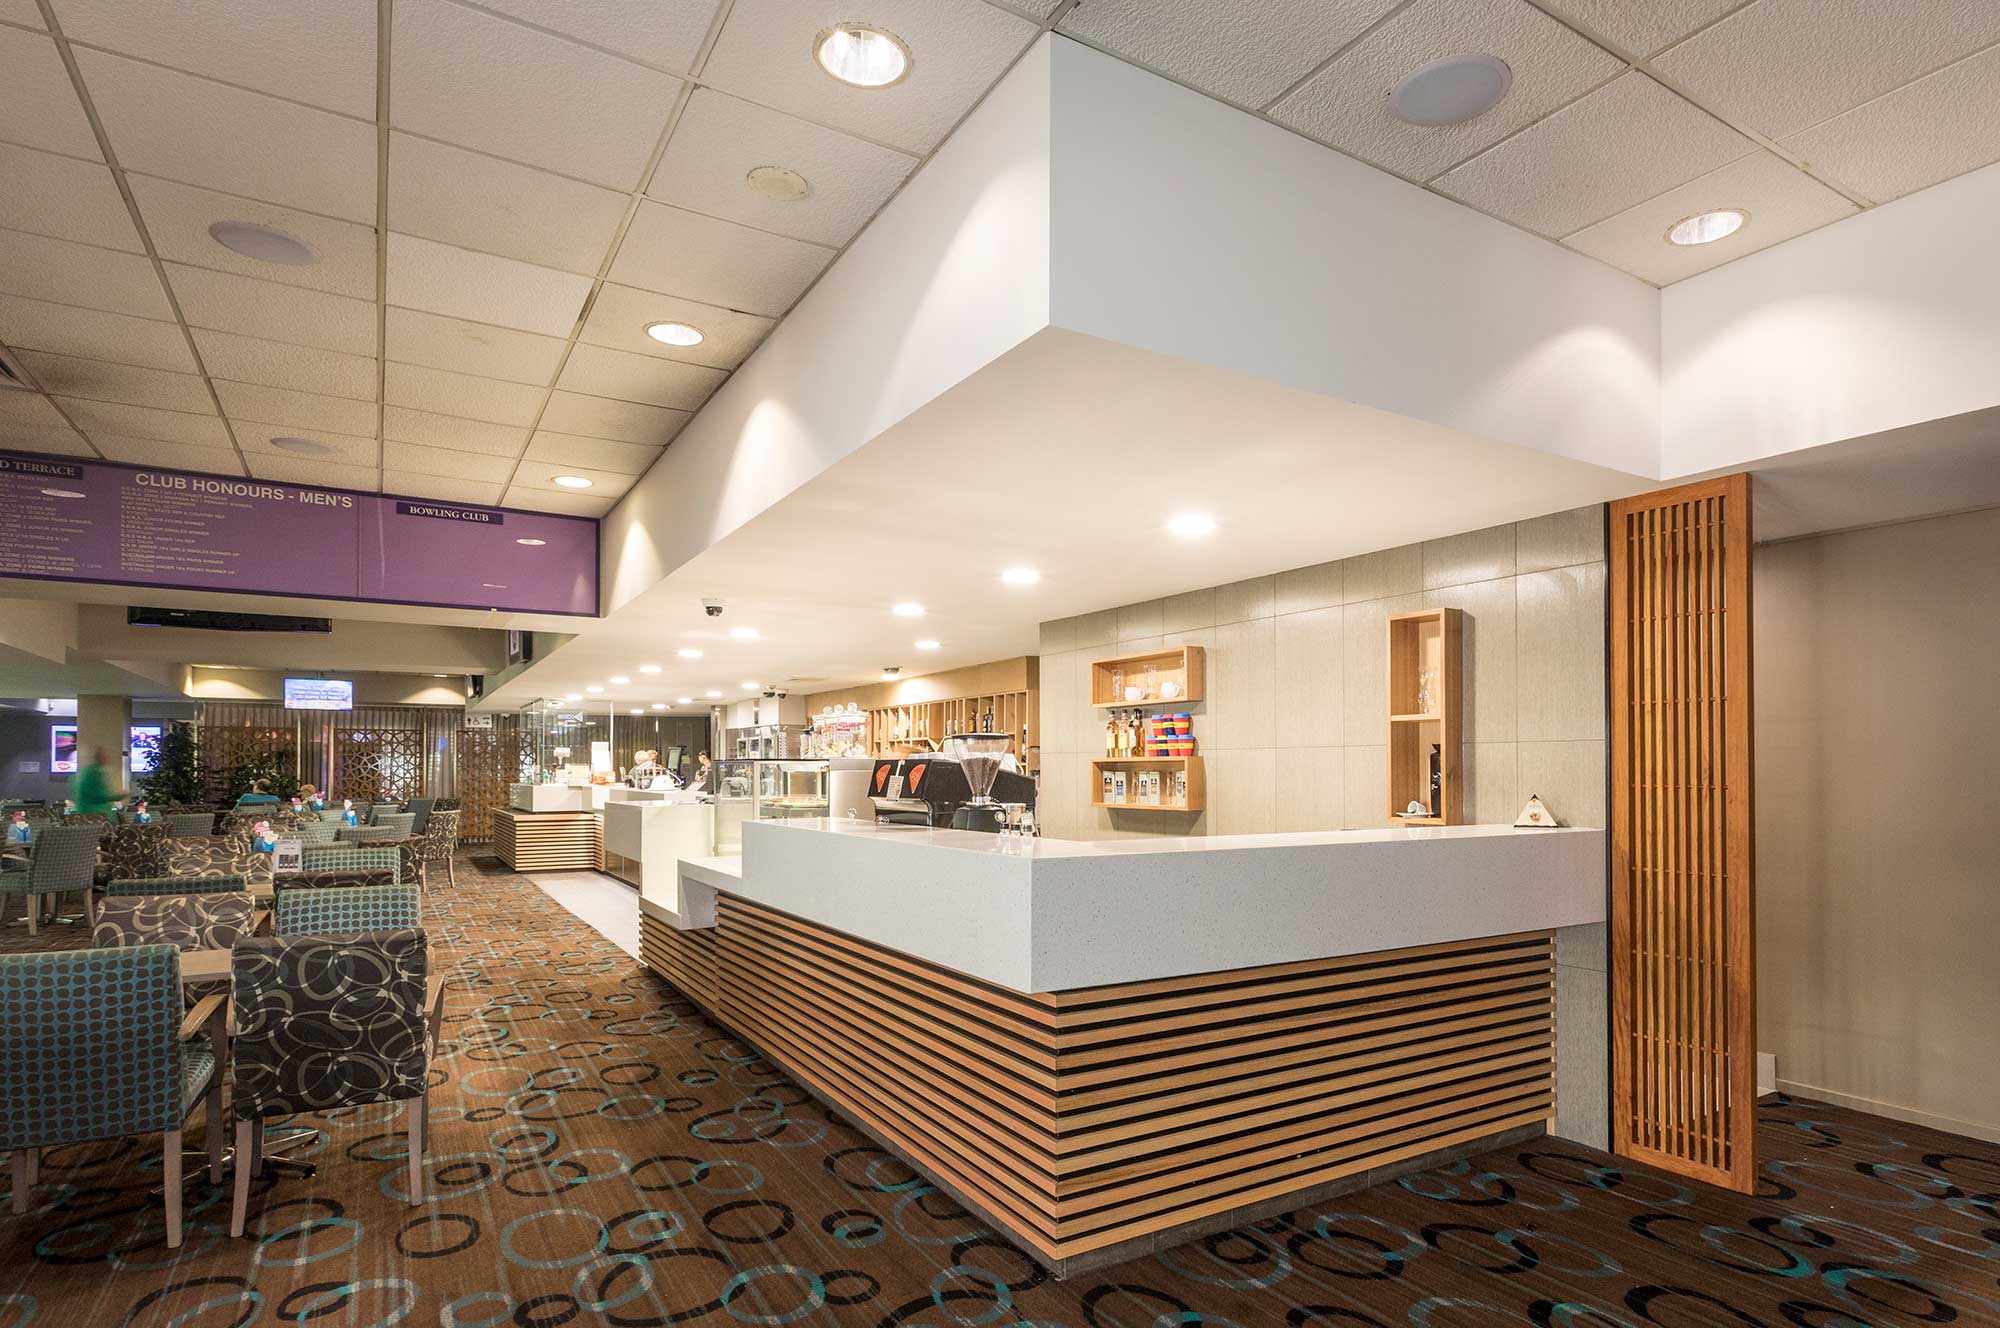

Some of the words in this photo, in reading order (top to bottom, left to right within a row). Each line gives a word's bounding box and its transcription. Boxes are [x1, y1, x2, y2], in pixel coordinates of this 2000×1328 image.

[14, 461, 74, 476] TERRACE
[135, 473, 187, 490] CLUB
[192, 479, 285, 501] HONOURS
[299, 491, 353, 509] MEN'S
[409, 505, 460, 519] BOWLING
[462, 512, 490, 522] CLUB
